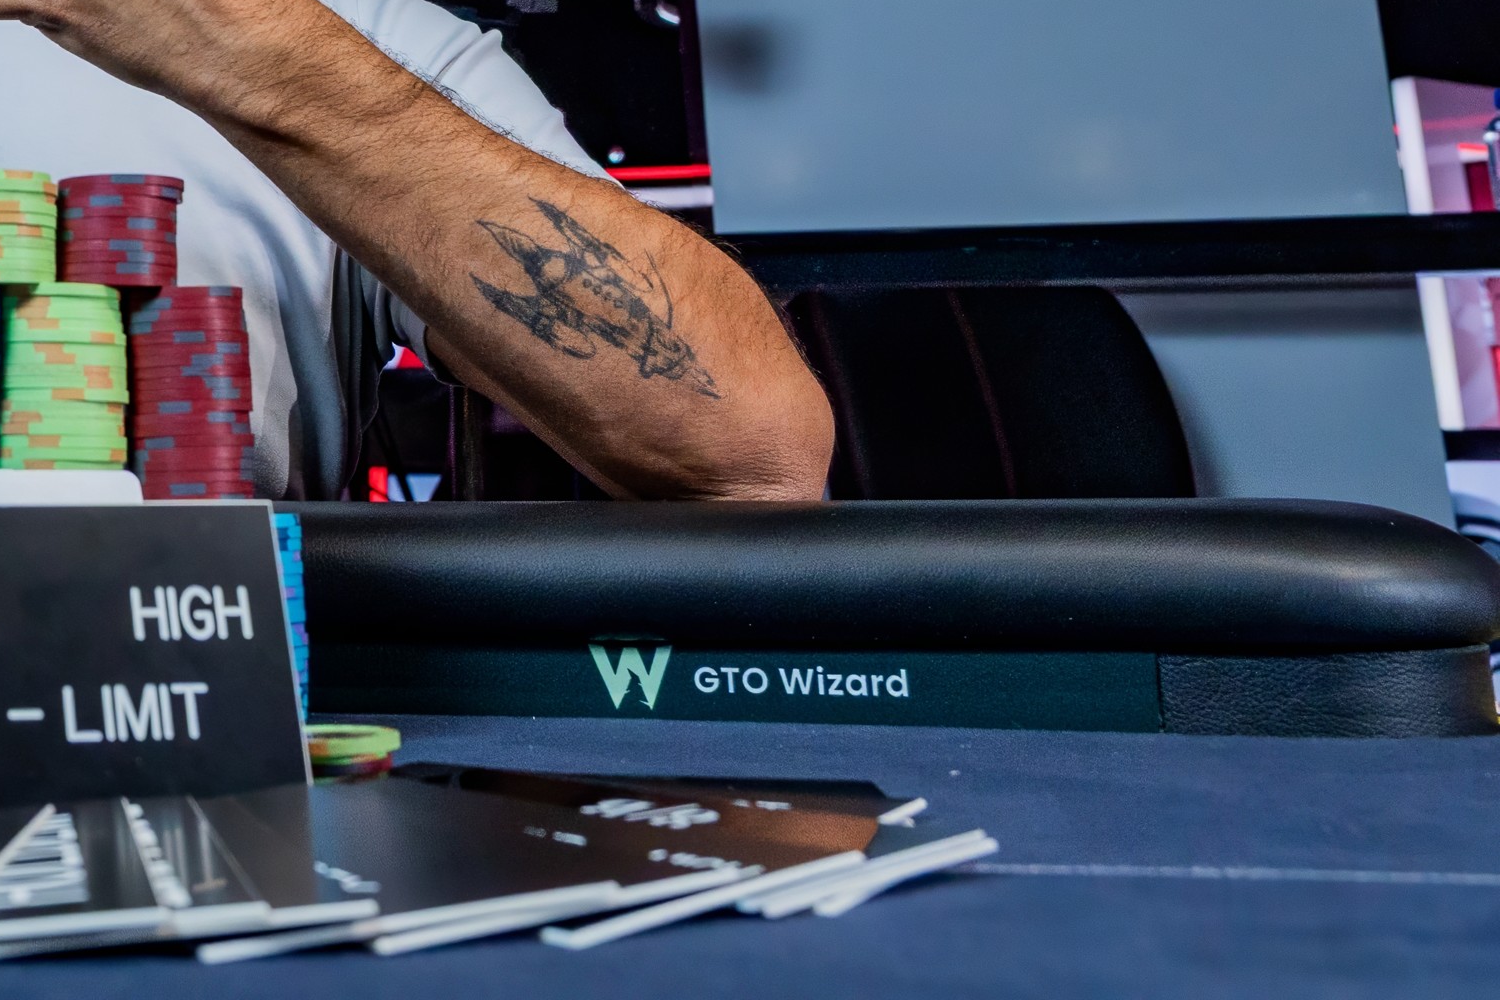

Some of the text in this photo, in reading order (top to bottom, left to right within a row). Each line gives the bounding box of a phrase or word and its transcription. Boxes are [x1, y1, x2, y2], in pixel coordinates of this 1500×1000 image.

[129, 585, 254, 642] HIGH
[694, 666, 768, 694] GTO
[778, 665, 909, 697] Wizard
[61, 681, 209, 744] LIMIT
